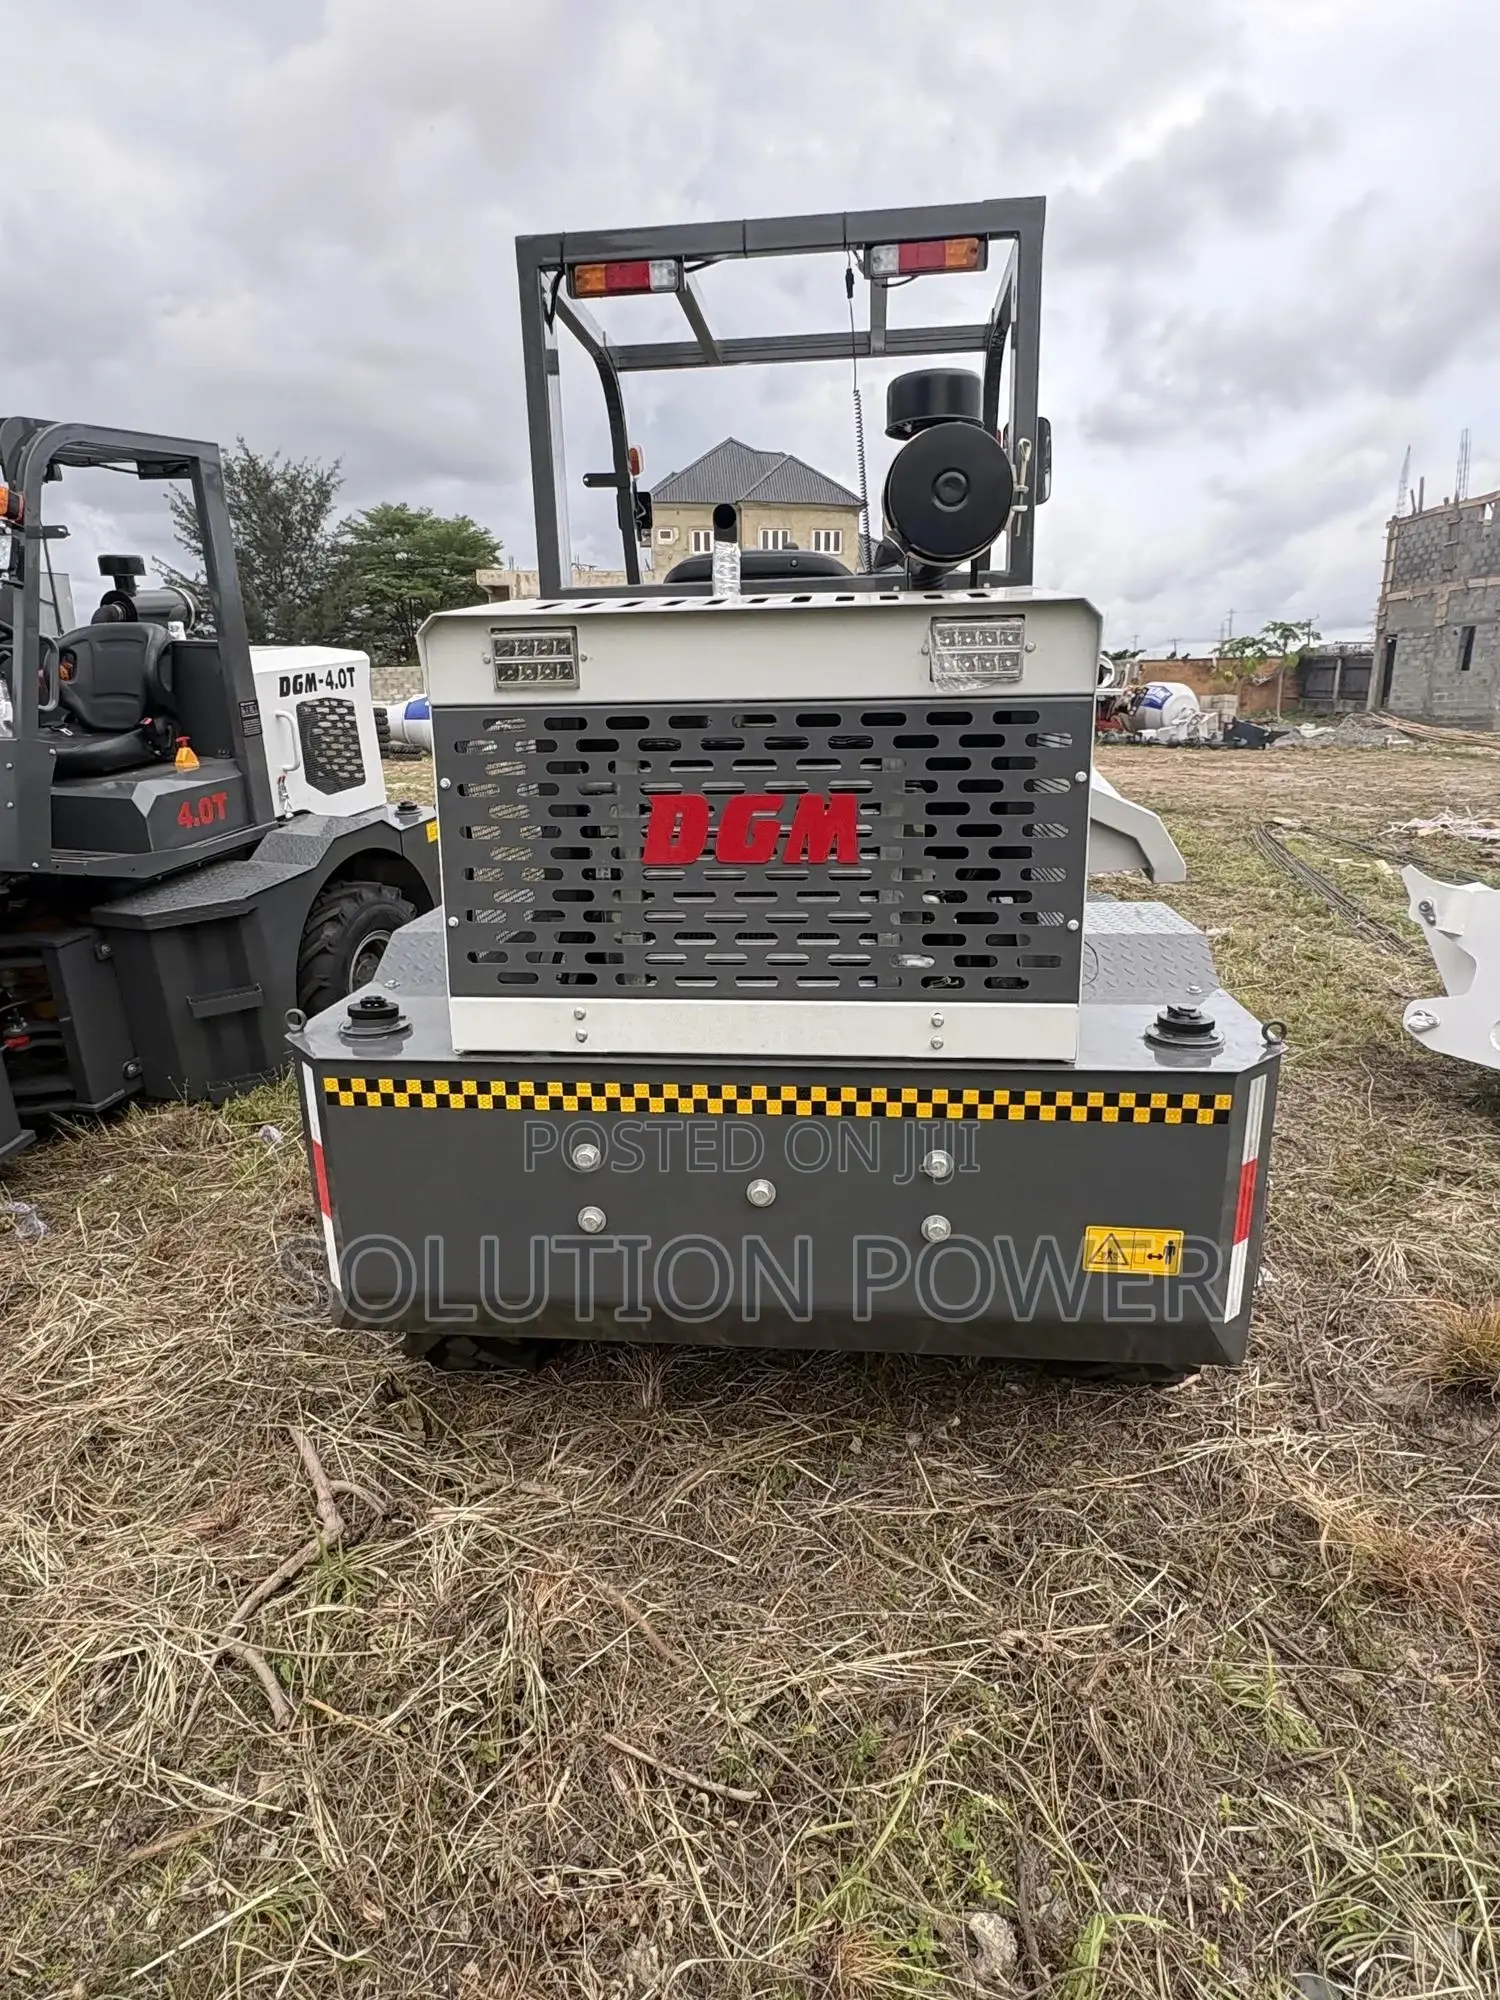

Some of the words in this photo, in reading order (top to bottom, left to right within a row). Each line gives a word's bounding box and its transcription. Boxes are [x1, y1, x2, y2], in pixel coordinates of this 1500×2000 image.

[279, 667, 355, 698] DGM-4.0T
[177, 791, 228, 829] 4.0T
[641, 793, 859, 864] DGM
